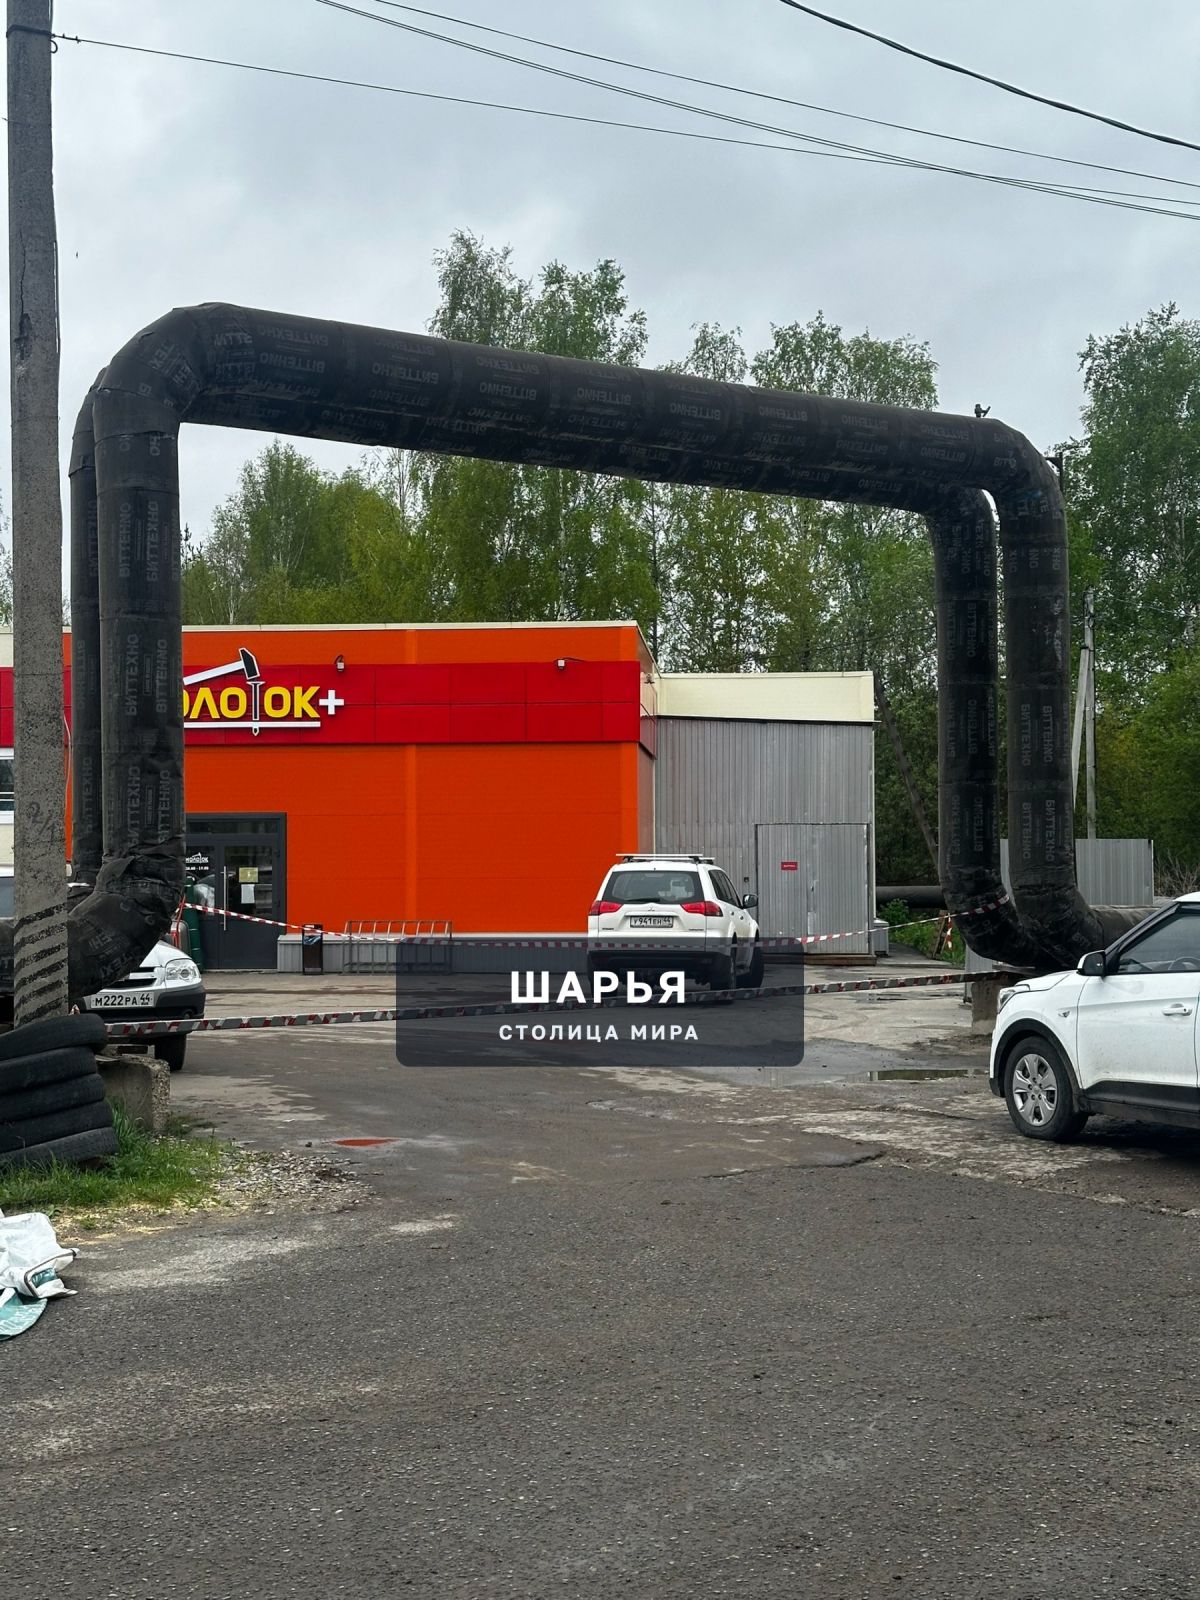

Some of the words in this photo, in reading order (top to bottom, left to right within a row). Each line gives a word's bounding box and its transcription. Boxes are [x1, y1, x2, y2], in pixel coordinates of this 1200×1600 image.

[257, 325, 328, 346] БИТТЕХНО
[260, 352, 325, 372] BITTEHNO
[372, 362, 439, 384] БИТТЕХНО
[475, 356, 540, 375] БИТТЕХНО
[480, 382, 537, 400] BITTEHNO
[577, 387, 631, 405] BITTEHNO
[670, 402, 721, 420] BITTEHNO
[759, 406, 808, 421] BITTEHNO
[119, 503, 131, 578] BITTEHNO
[146, 501, 159, 582] БИТТЕХНО
[125, 633, 139, 716] БИТТЕХНО
[155, 639, 169, 714] BITTEHNO
[1021, 704, 1032, 767] БИТТЕХНО
[1042, 705, 1054, 763] BITTEHNO
[1021, 802, 1032, 859] BITTEHNO
[1045, 799, 1056, 862] БИТТЕХНО
[95, 995, 138, 1007] М222РА
[139, 993, 150, 1002] 44
